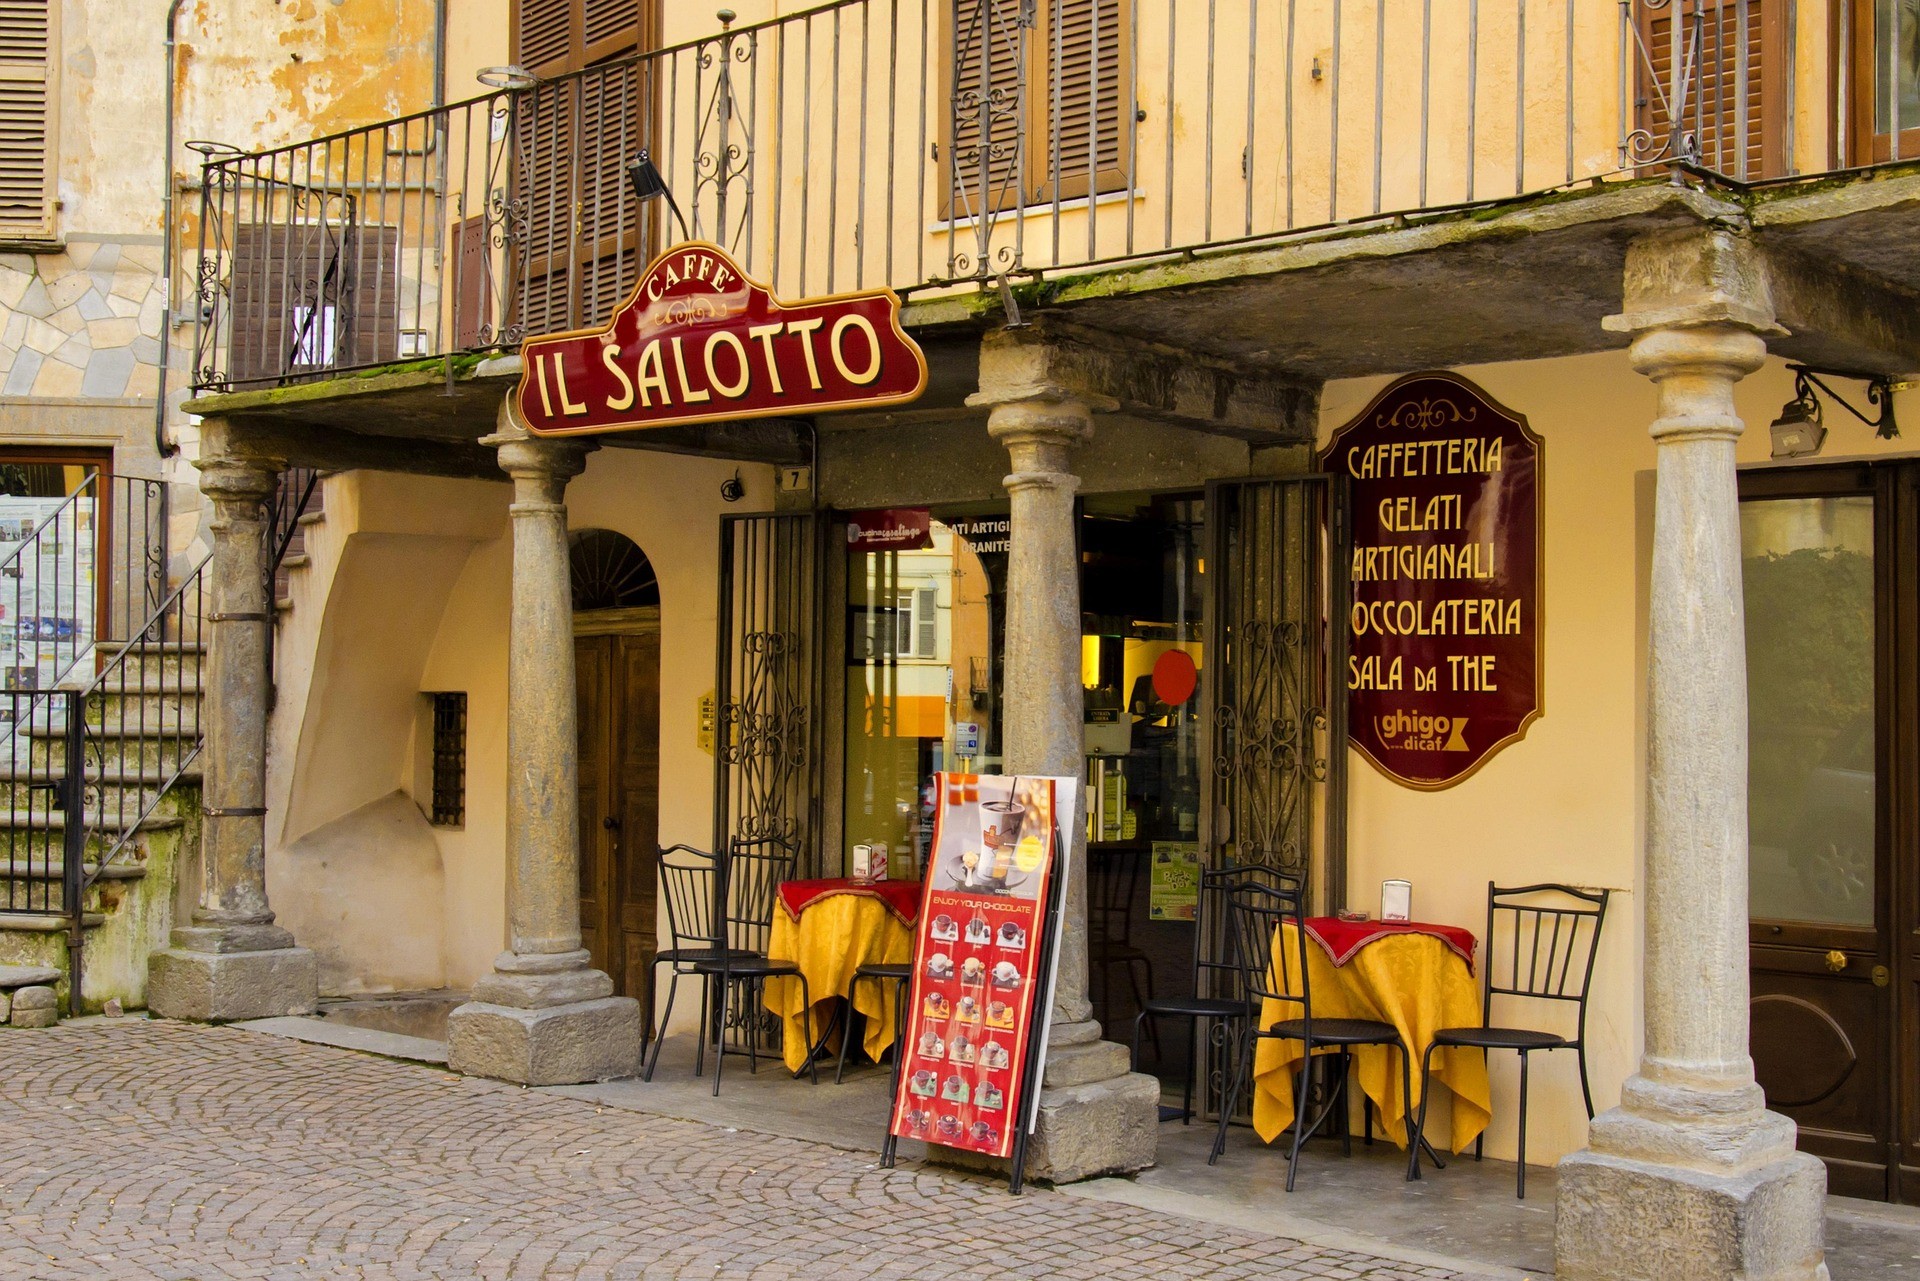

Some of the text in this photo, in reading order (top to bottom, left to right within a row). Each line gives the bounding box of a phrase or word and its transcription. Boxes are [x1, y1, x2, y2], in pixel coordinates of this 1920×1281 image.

[535, 313, 882, 417] IL SALOTTO
[1348, 436, 1503, 480] CAFFETTERIA
[791, 471, 799, 488] 7
[971, 520, 1010, 534] ARTIGI
[1378, 494, 1461, 532] GELATI
[1350, 542, 1495, 582] ARTIGIANALI
[1351, 597, 1521, 636] OCCOLATERIA
[1348, 654, 1498, 692] SALA DA THE
[1382, 709, 1450, 739] ghigo
[1403, 735, 1442, 751] dicaf
[933, 896, 1032, 914] ENJOY YOUR CHOCOLATE
